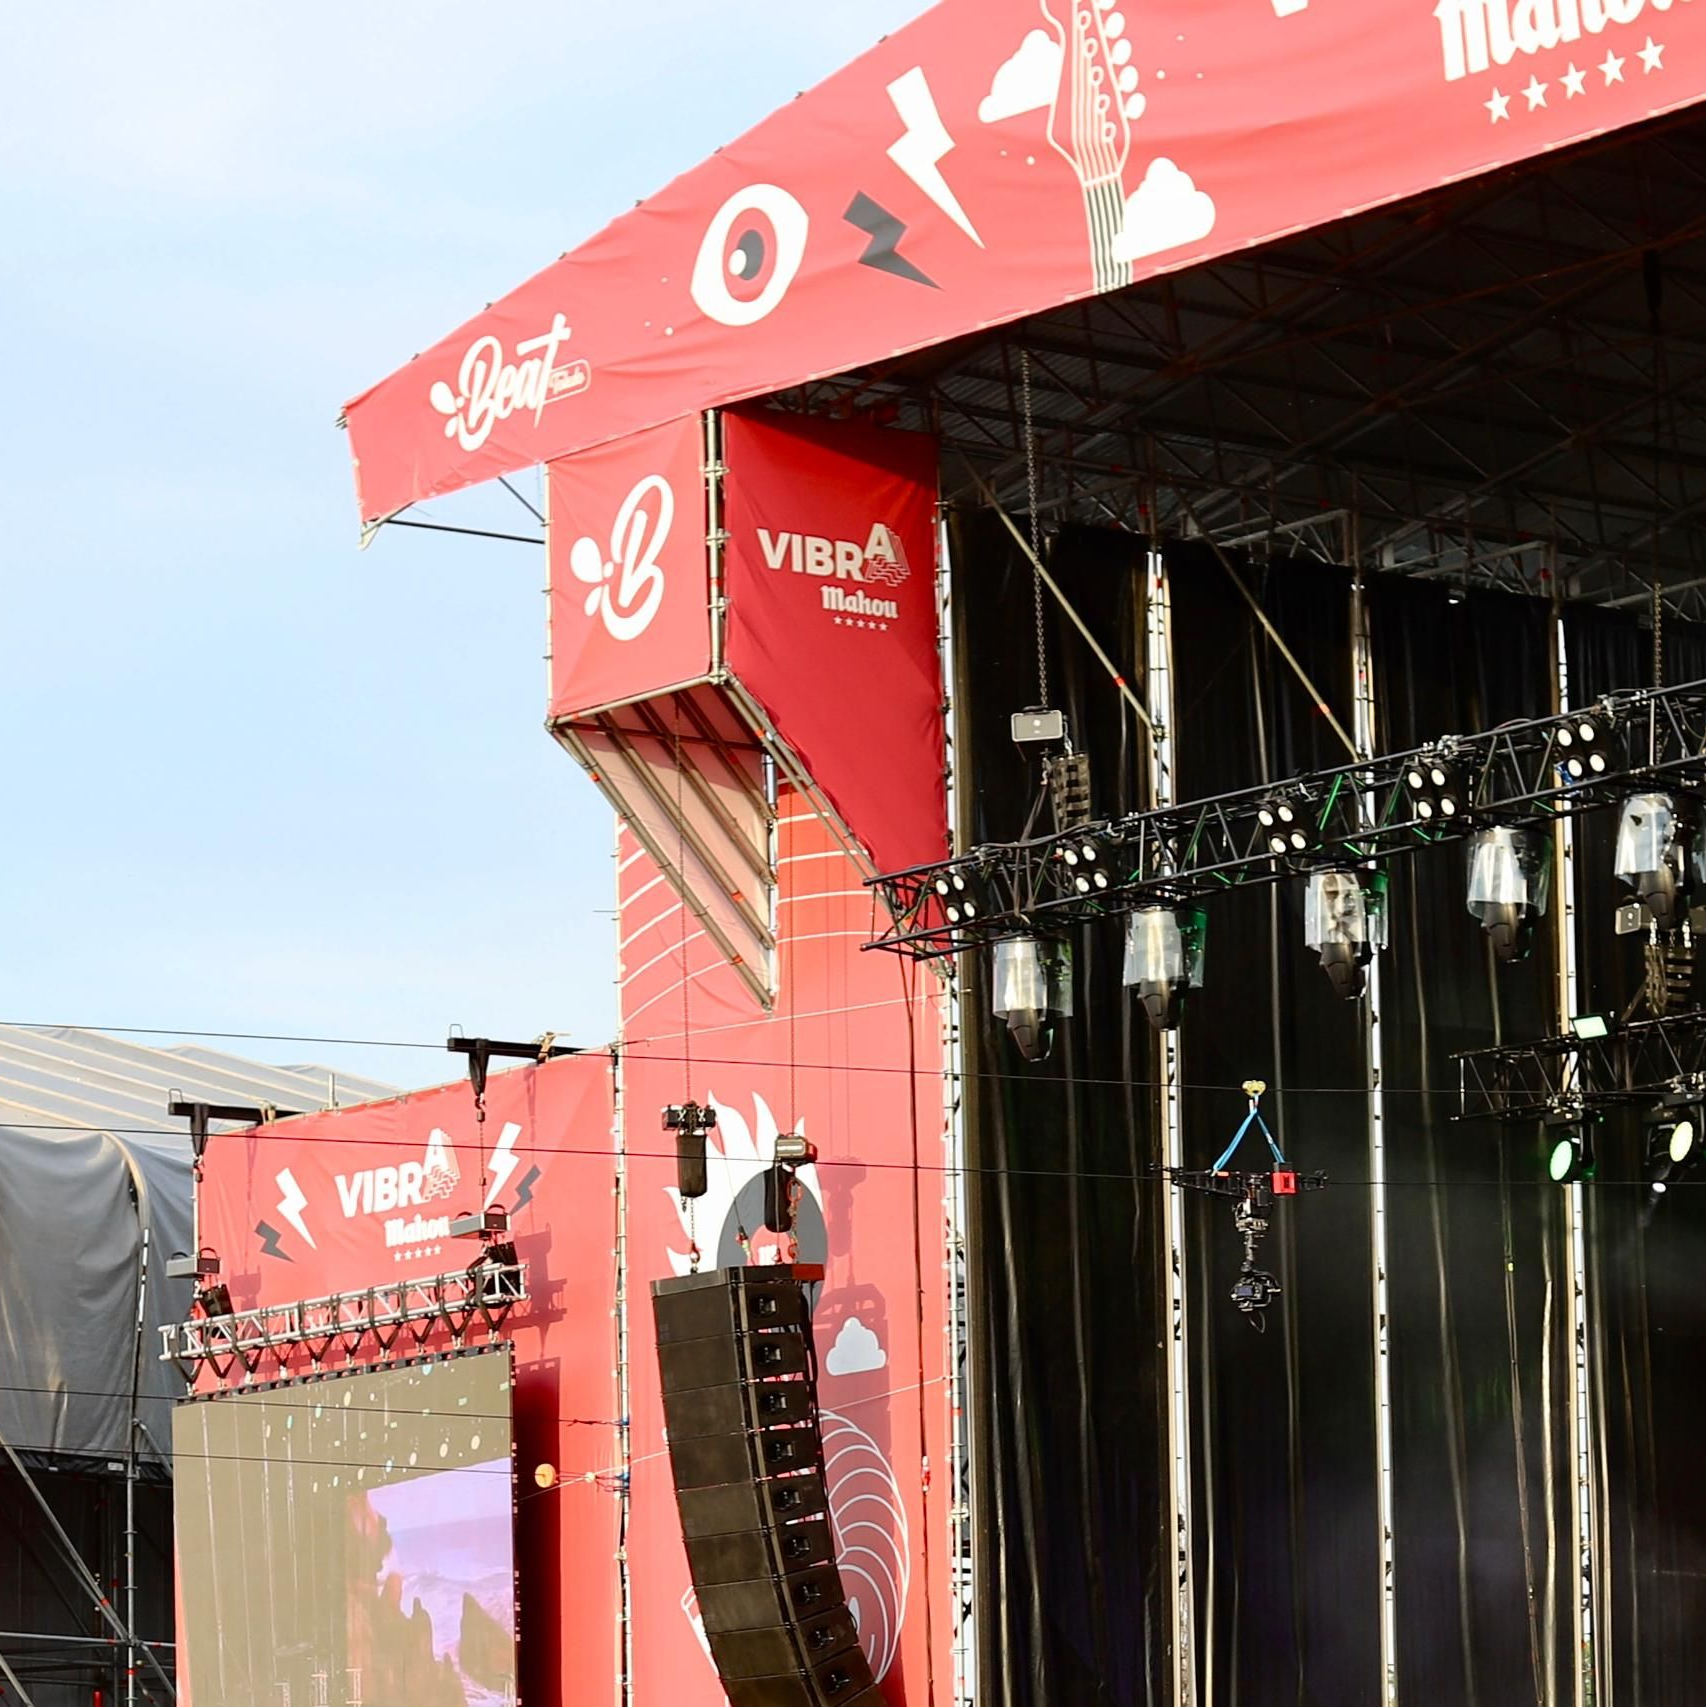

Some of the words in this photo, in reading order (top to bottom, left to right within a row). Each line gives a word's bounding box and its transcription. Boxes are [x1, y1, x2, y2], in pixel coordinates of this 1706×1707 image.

[458, 312, 572, 452] Beat
[756, 522, 911, 587] VIBRA
[821, 585, 898, 619] Mahou
[334, 1128, 461, 1219] VIBRA
[384, 1213, 451, 1248] Mahou
